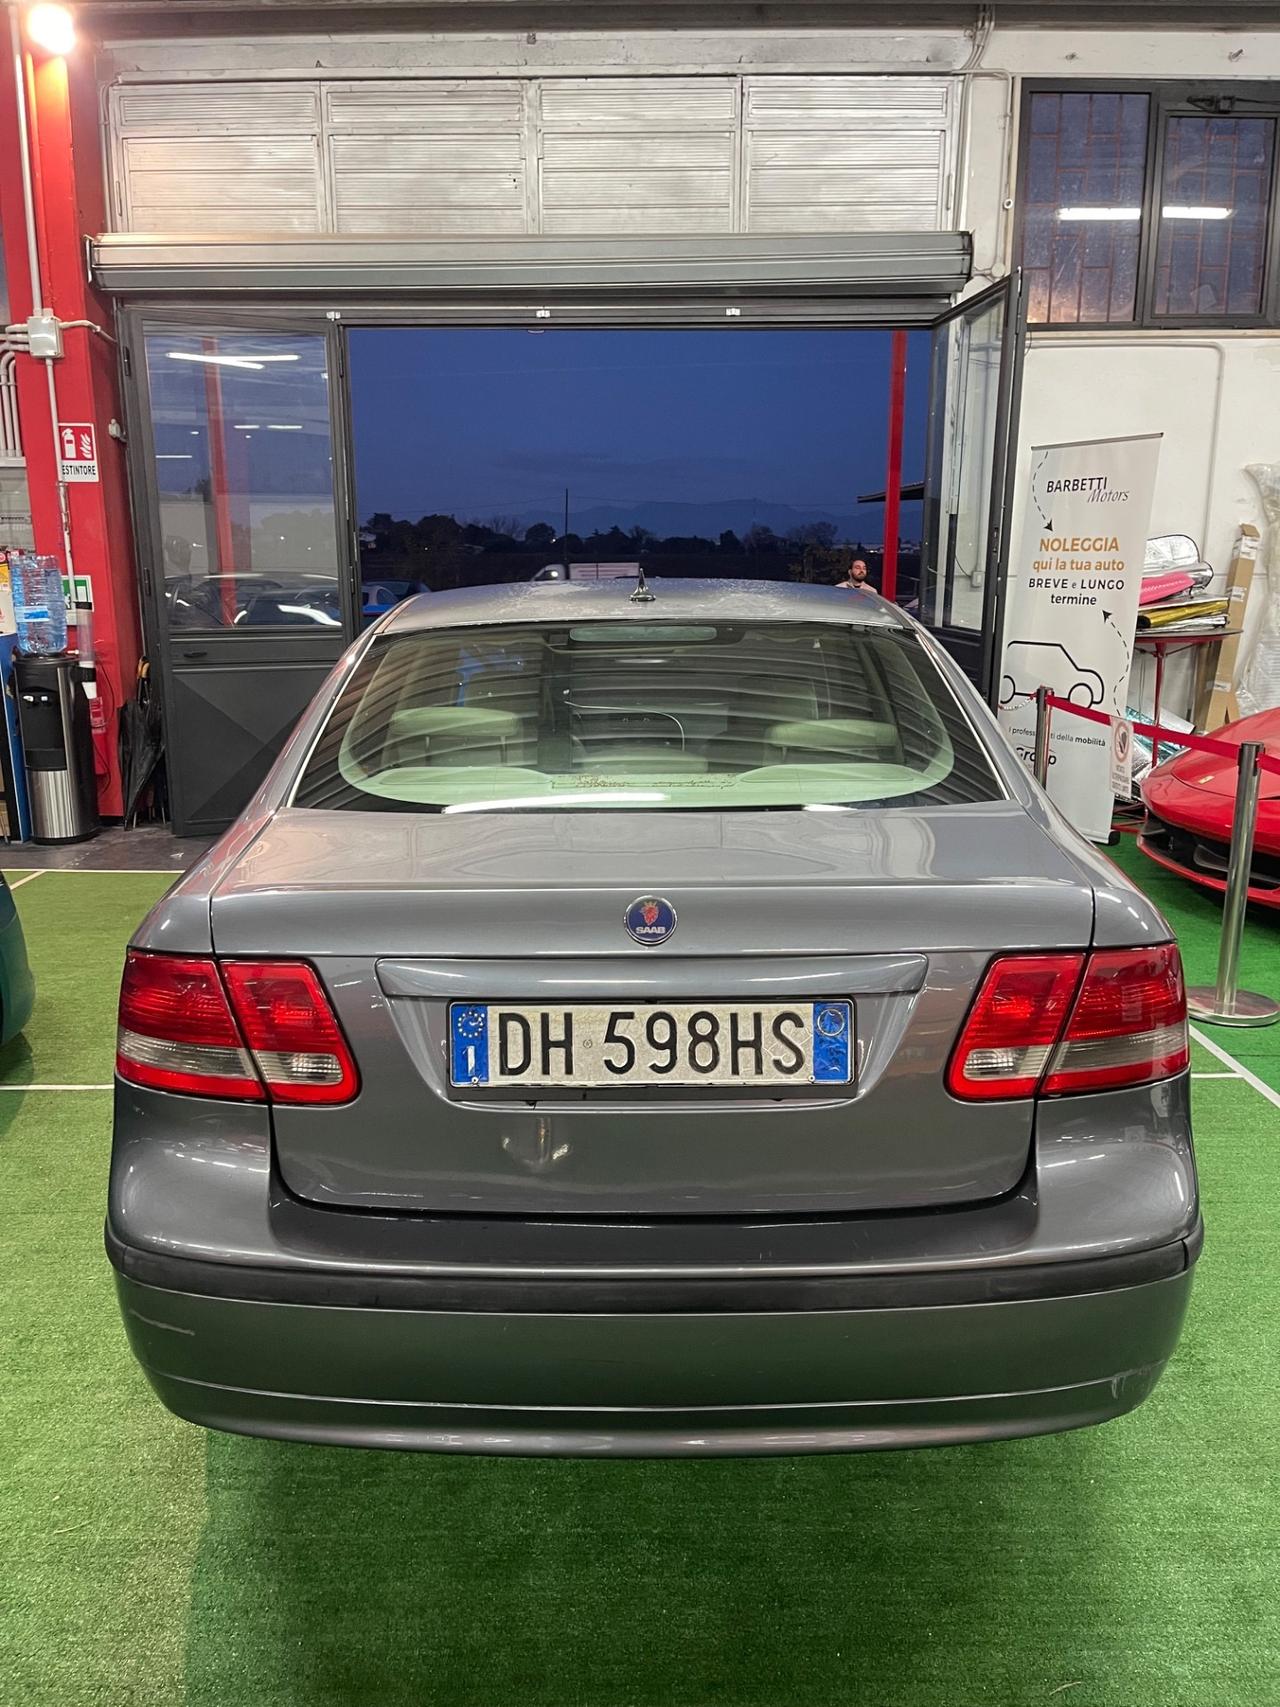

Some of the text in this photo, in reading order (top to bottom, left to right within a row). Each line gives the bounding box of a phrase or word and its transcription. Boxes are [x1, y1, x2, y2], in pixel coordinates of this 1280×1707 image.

[62, 465, 96, 476] ESTINTORE
[1046, 477, 1108, 493] BARBETTI
[1087, 489, 1130, 503] Motors
[1039, 537, 1120, 552] NOLEGGIA
[1033, 558, 1125, 572] qui la tua auto
[1028, 578, 1068, 589] BREVE
[1080, 579, 1125, 590] LUNGO
[1050, 594, 1097, 605] termine
[1056, 733, 1074, 742] della
[1074, 736, 1106, 747] mobilità
[635, 926, 666, 934] SAAB
[499, 1010, 806, 1076] DH 598HS
